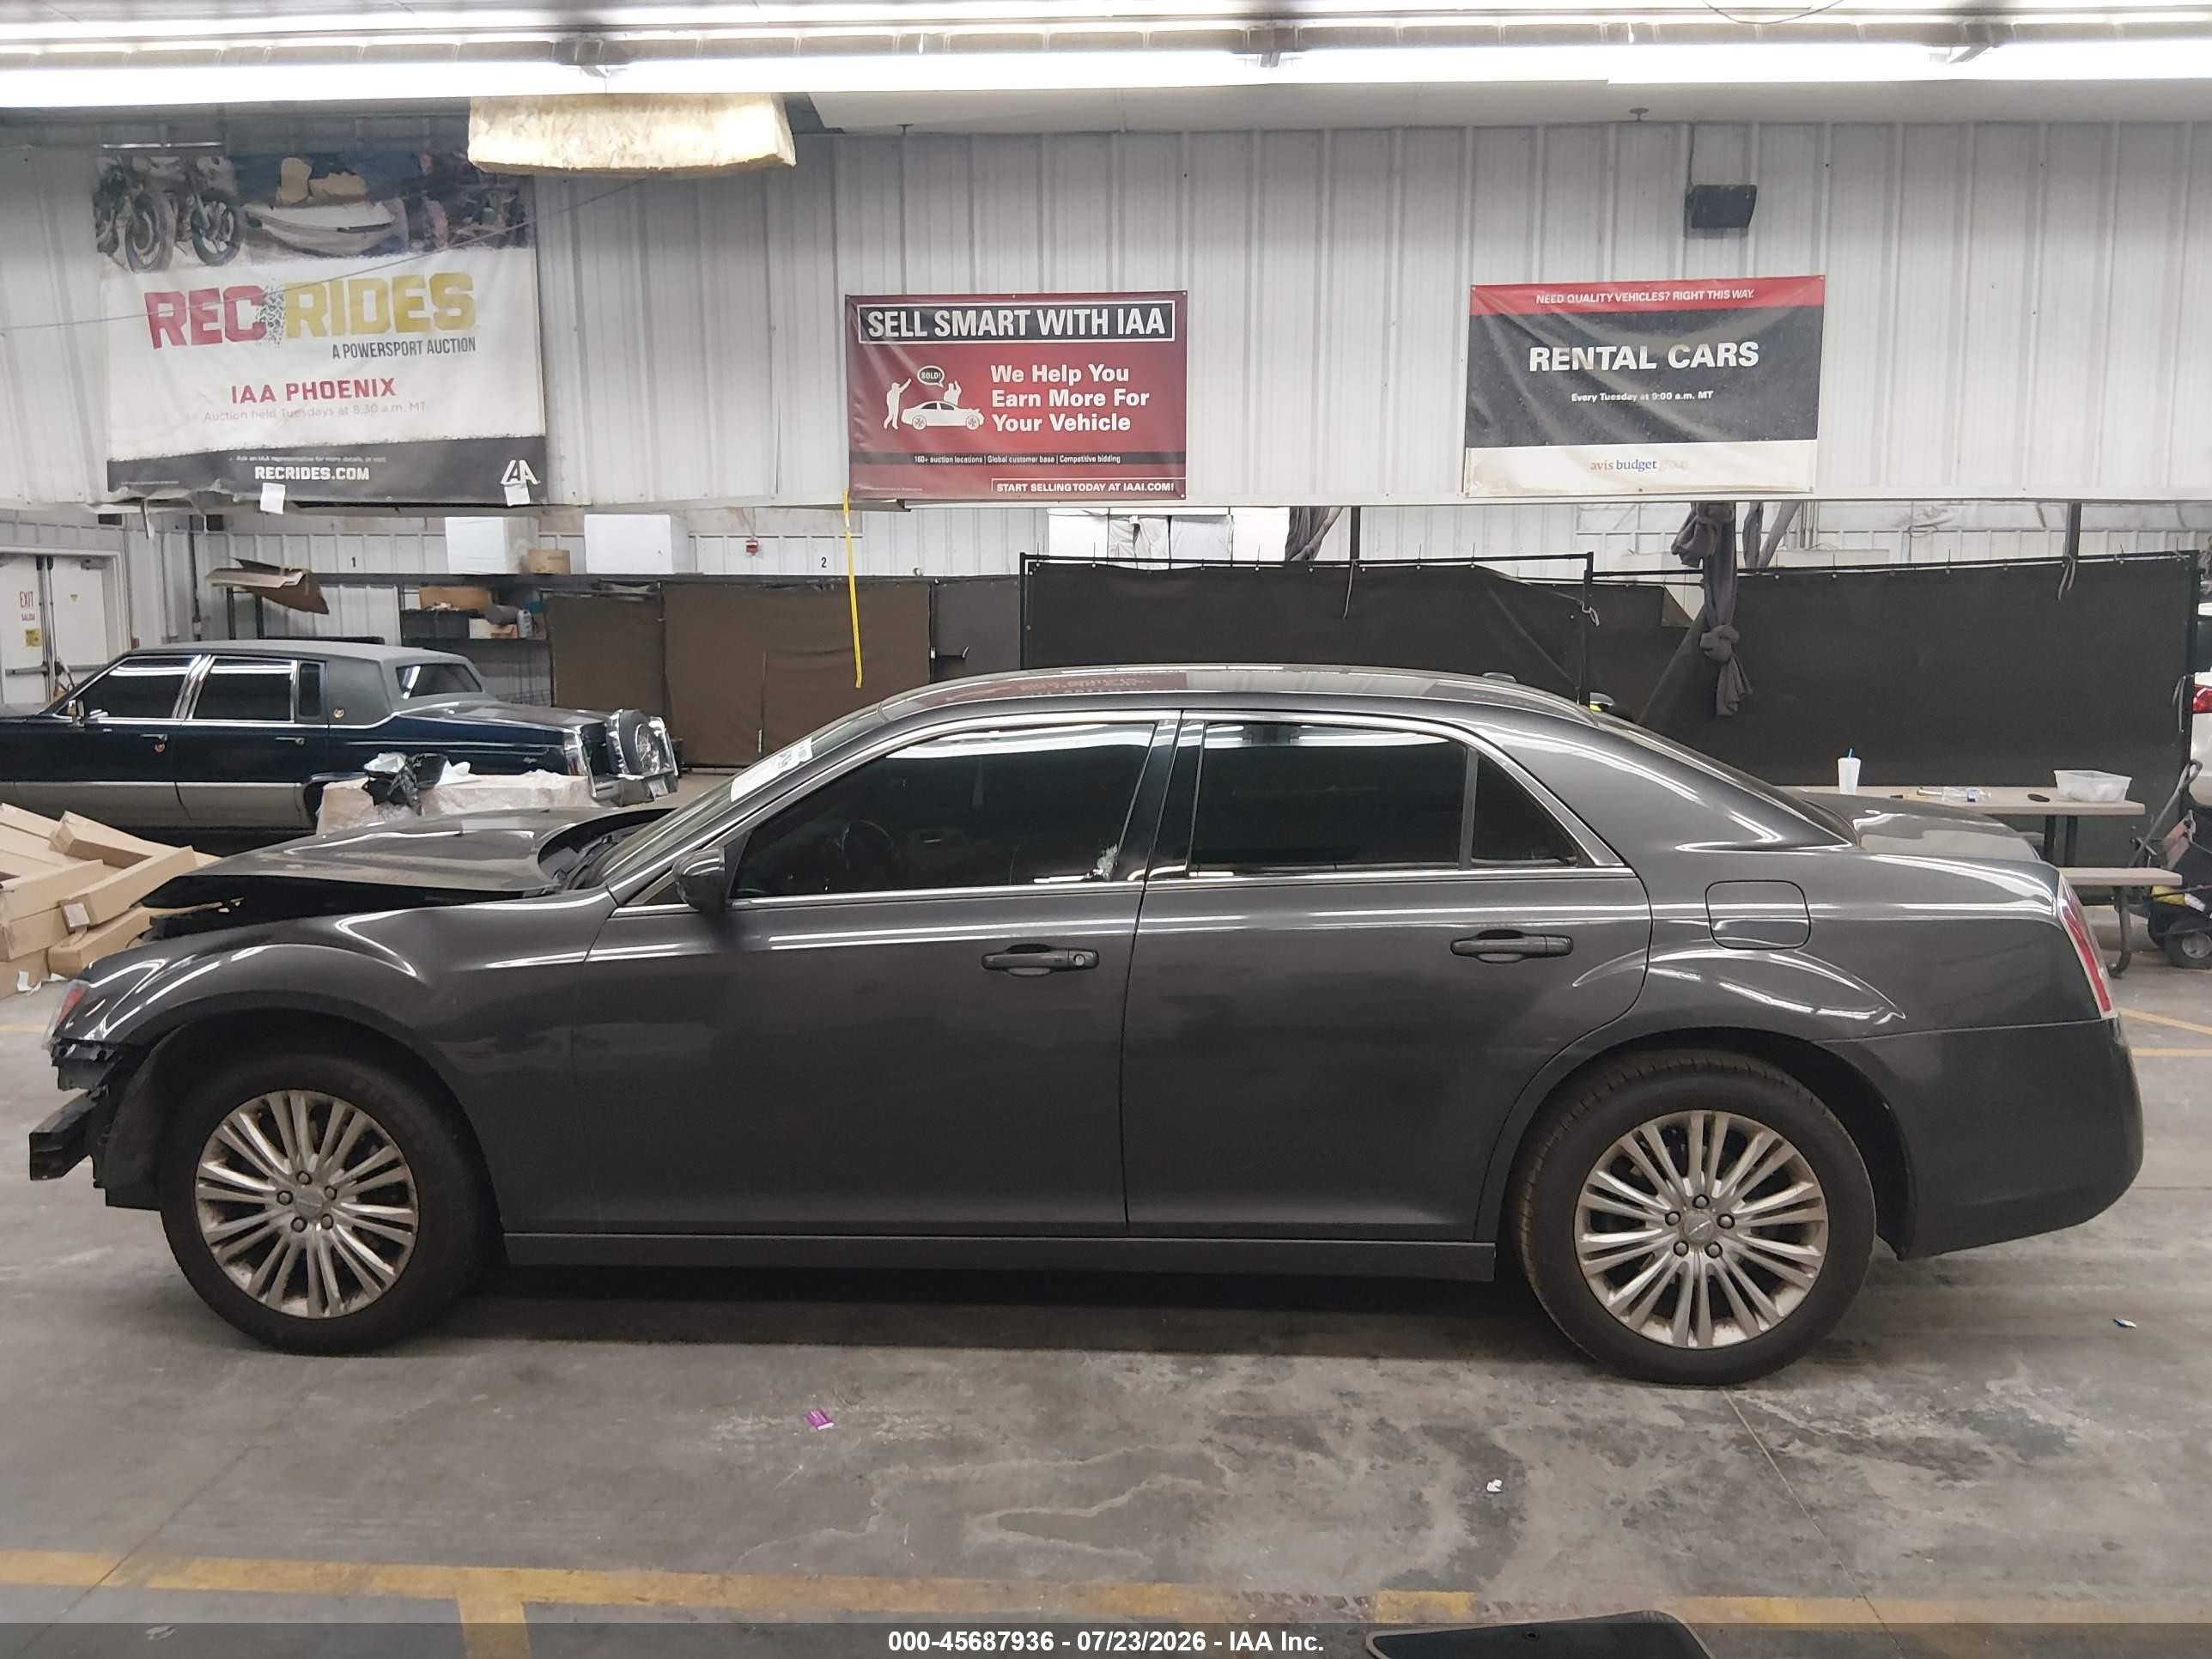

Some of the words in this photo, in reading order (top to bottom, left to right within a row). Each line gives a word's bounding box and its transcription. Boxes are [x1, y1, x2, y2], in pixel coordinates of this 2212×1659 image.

[1535, 295, 1565, 305] NEED
[1567, 293, 1614, 304] QUALITY
[1614, 291, 1670, 302] VEHICLES?
[1673, 290, 1705, 301] RIGHT
[1707, 289, 1730, 300] THIS
[144, 285, 268, 349] REC
[284, 272, 476, 339] RIDES
[867, 310, 928, 338] SELL
[933, 309, 1030, 337] SMART
[1036, 308, 1109, 336] WITH
[1117, 307, 1165, 335] IAA
[332, 344, 341, 359] A
[343, 340, 423, 359] POWERSPORT
[427, 337, 476, 355] AUCTION
[1529, 345, 1657, 372] RENTAL
[1668, 341, 1759, 369] CARS
[921, 371, 941, 380] SOLD!
[990, 364, 1024, 383] We
[1031, 364, 1082, 386] Help
[1088, 363, 1129, 382] You
[232, 385, 276, 404] IAA
[285, 377, 397, 401] PHOENIX
[992, 390, 1042, 408] Earn
[1048, 389, 1106, 407] More
[1114, 388, 1150, 406] For
[1571, 392, 1597, 403] Every
[1599, 392, 1638, 402] Tuesday
[1698, 391, 1714, 399] MT
[204, 410, 247, 422] Auction
[251, 409, 276, 420] held
[281, 405, 334, 420] Tuesdays
[337, 404, 349, 416] at
[410, 401, 427, 412] MT
[992, 414, 1042, 432] Your
[1048, 412, 1131, 431] Vehicle
[1060, 454, 1097, 465] Competitive
[1097, 454, 1121, 464] bidding
[1590, 459, 1613, 471] avis
[1616, 459, 1657, 471] budget
[254, 466, 370, 481] RECRIDES.COM
[996, 483, 1027, 492] START
[1030, 483, 1072, 492] SELLING
[1072, 483, 1106, 492] TODAY
[1108, 483, 1121, 492] AT
[1123, 482, 1175, 492] IAAI.COM!
[351, 556, 356, 568] 1
[821, 556, 827, 568] 2
[20, 591, 33, 608] EXIT
